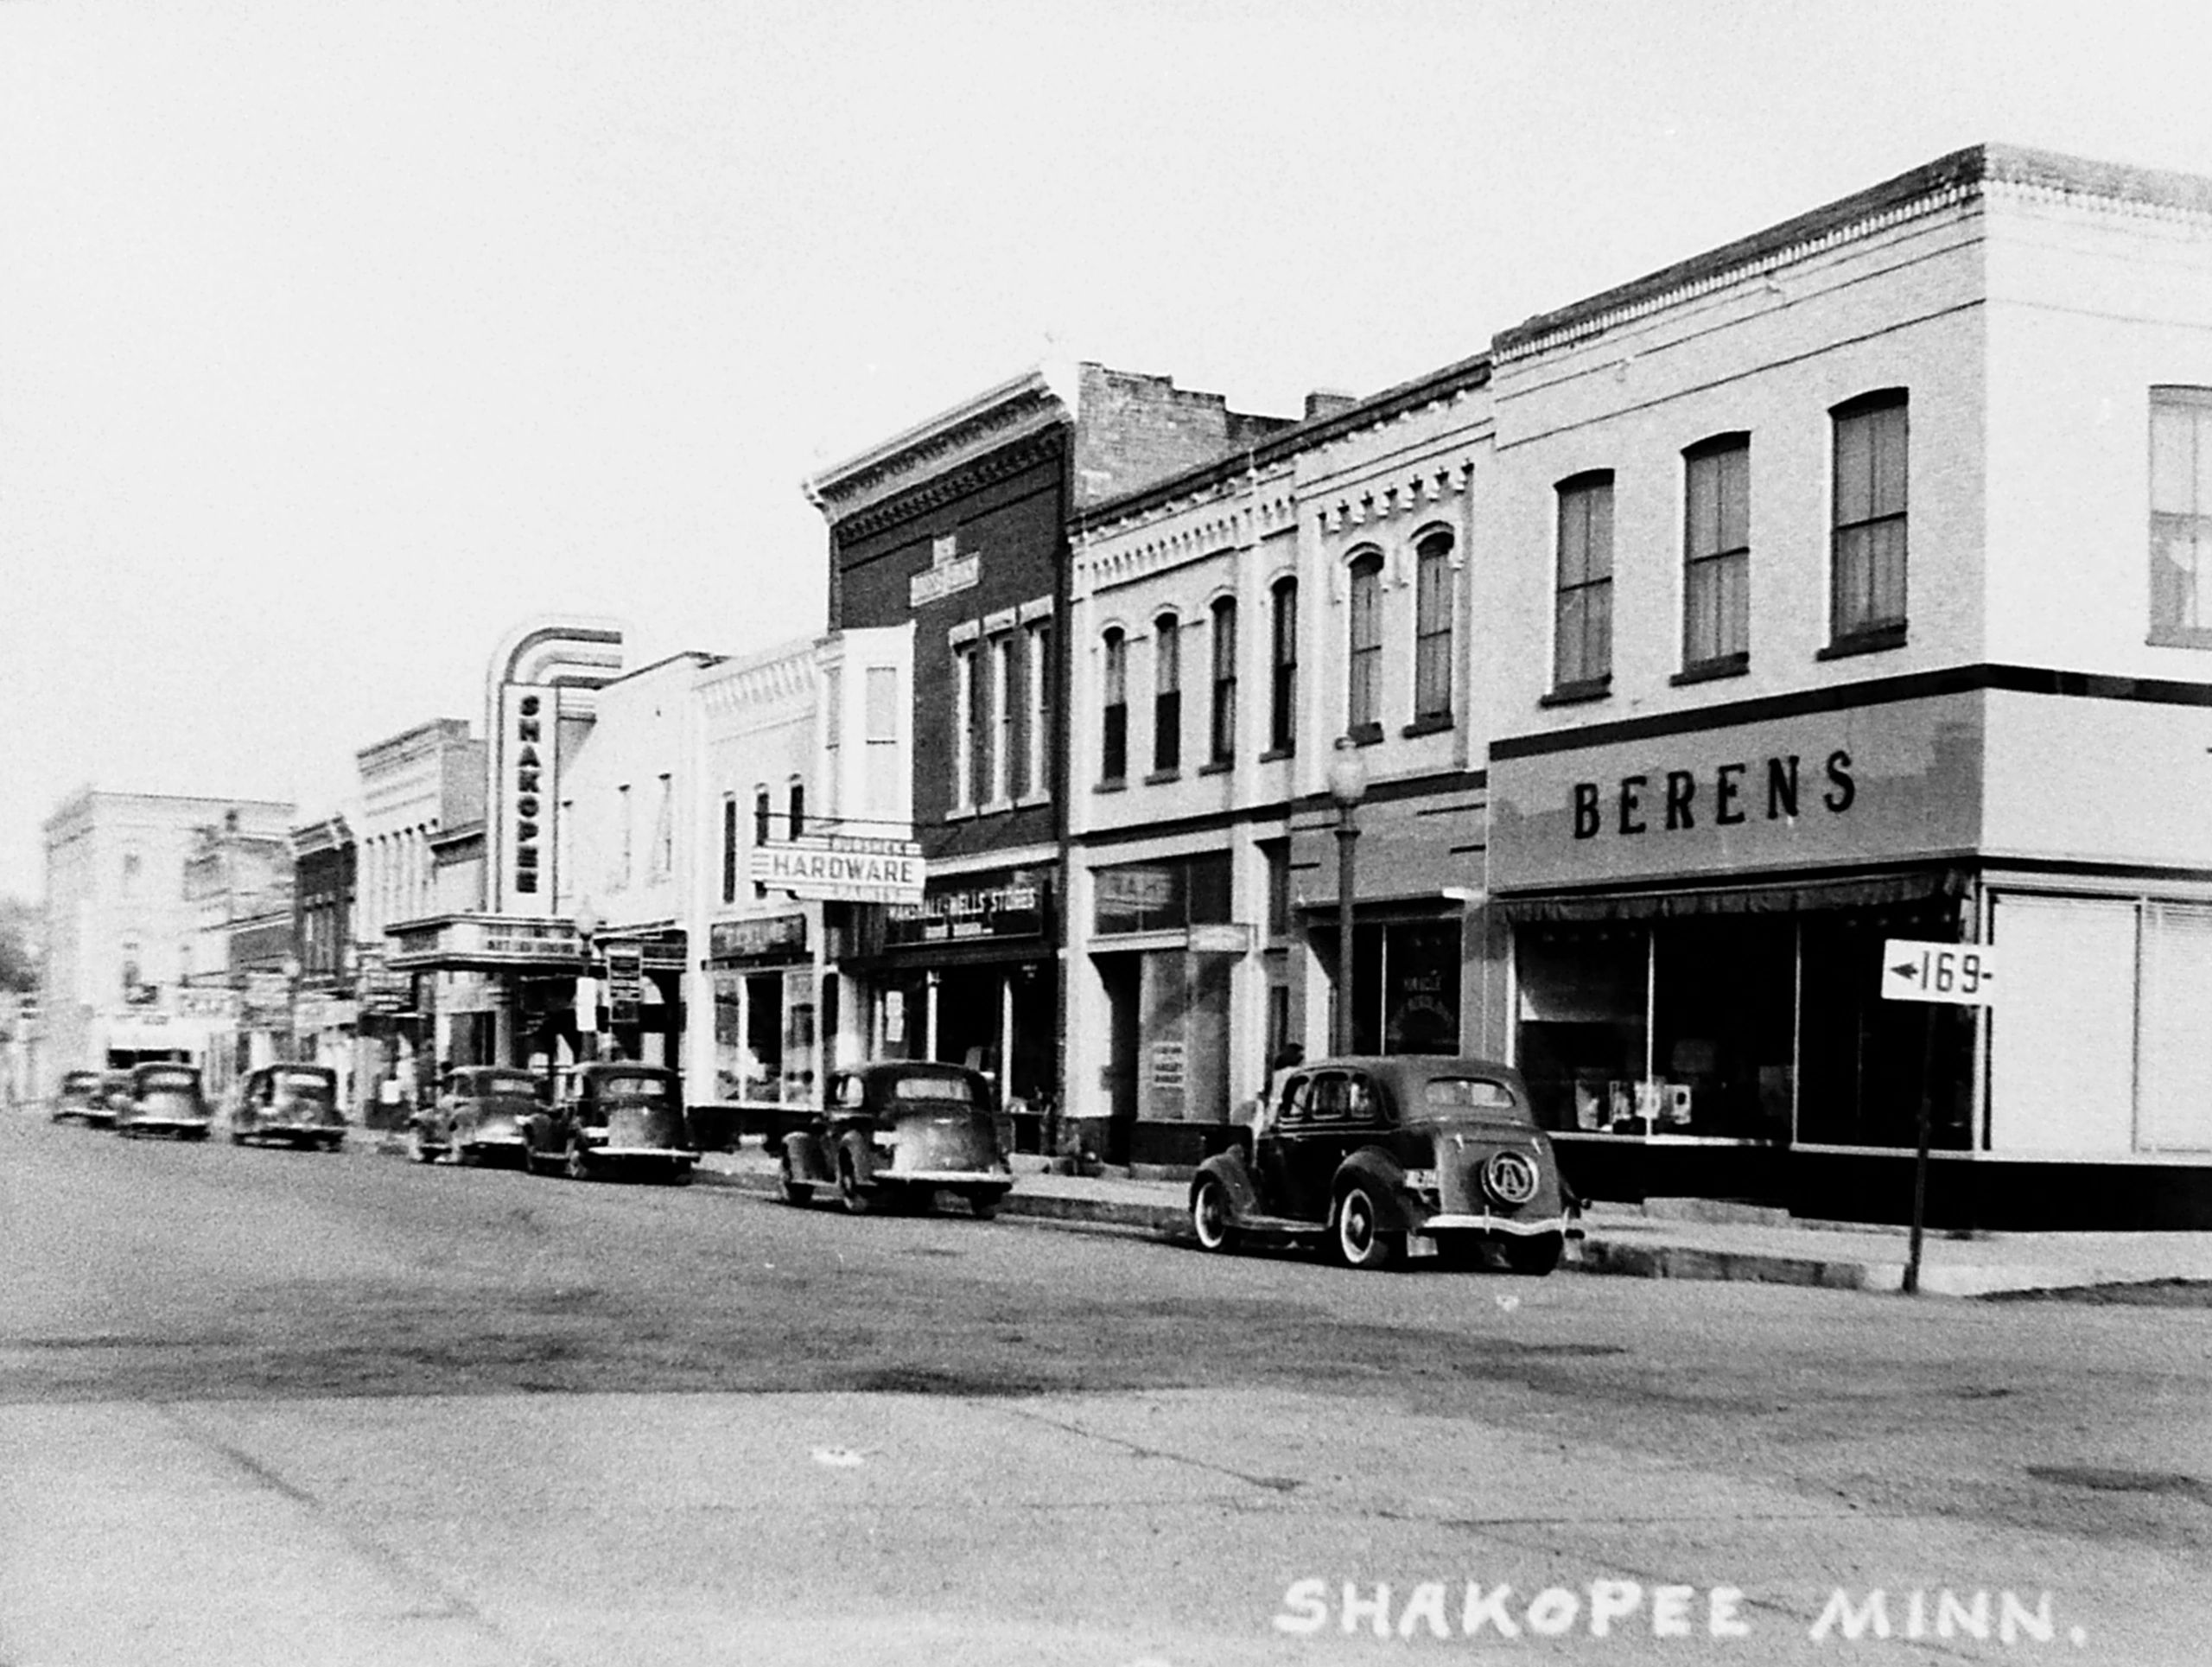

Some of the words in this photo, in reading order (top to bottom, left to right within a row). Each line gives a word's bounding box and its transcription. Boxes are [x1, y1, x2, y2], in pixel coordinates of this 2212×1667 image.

[517, 695, 541, 894] SHAKOPEE
[1573, 750, 1856, 840] BERENS
[773, 854, 912, 883] HARDWARE
